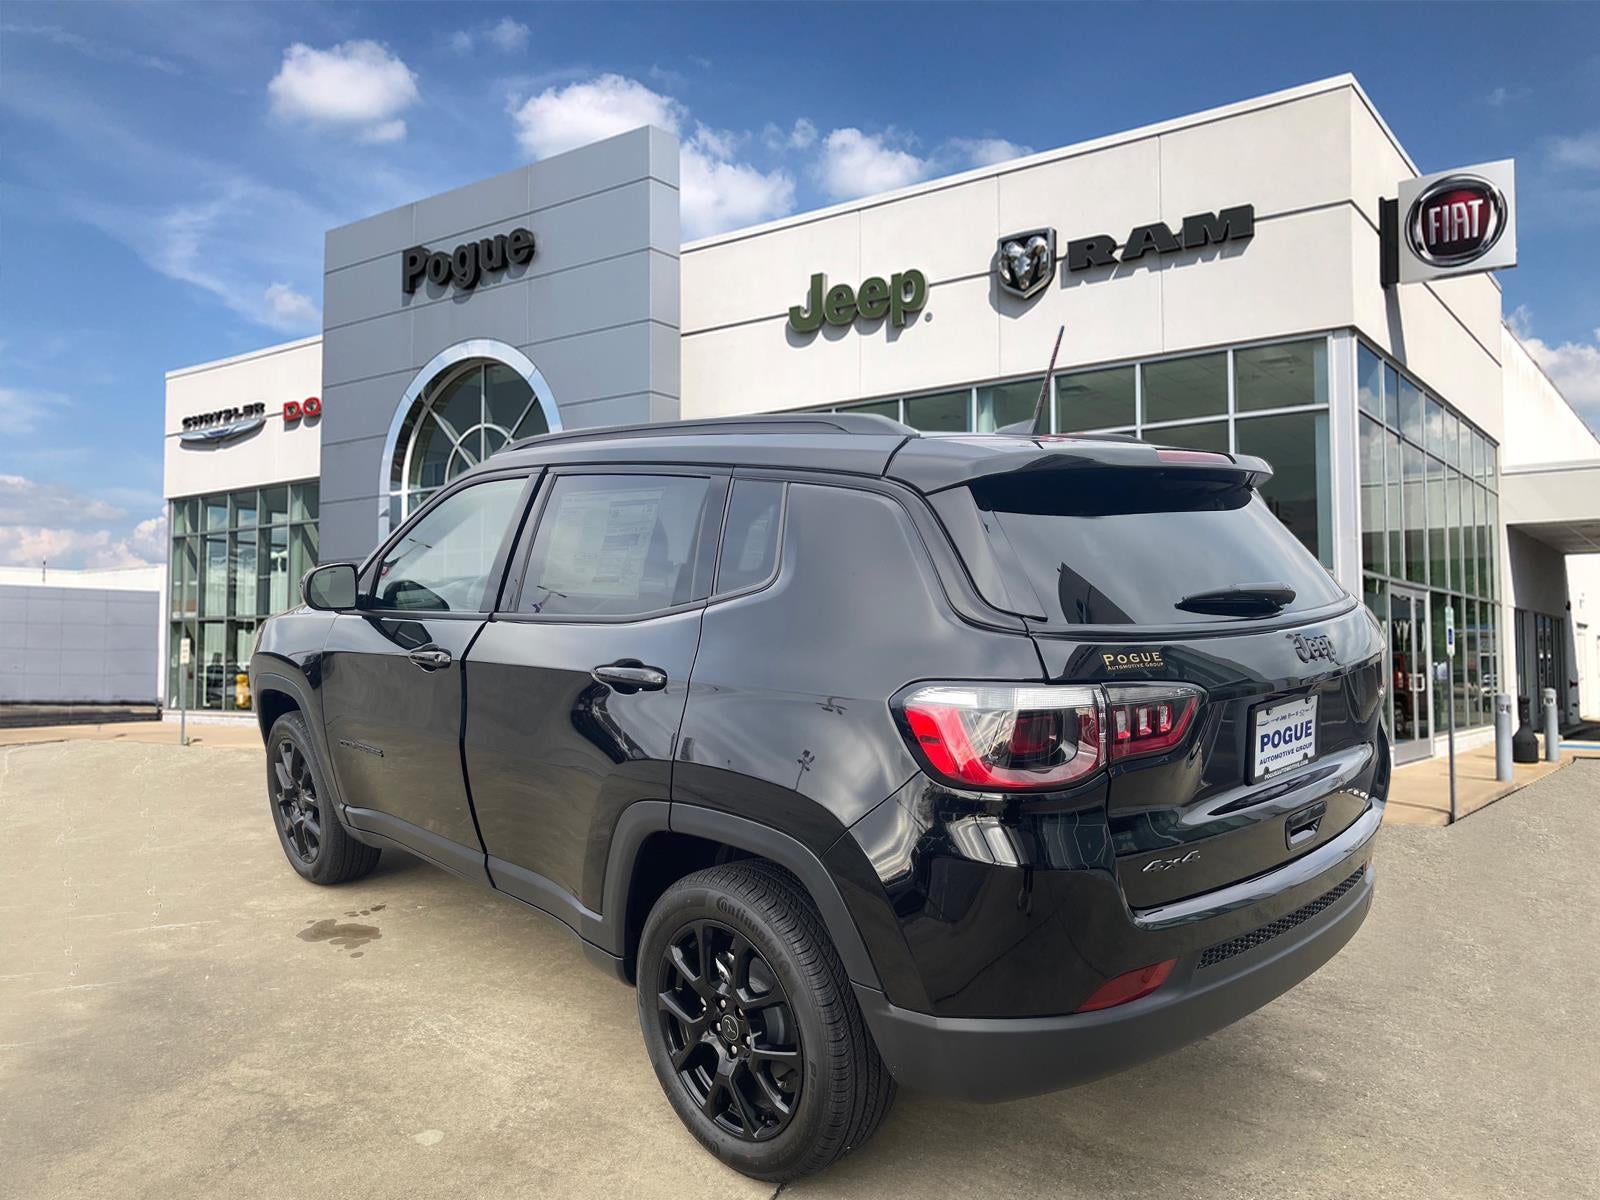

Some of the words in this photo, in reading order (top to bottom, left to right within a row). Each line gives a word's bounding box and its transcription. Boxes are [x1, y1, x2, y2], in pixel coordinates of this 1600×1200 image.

[1066, 203, 1255, 272] RAM
[1428, 199, 1484, 246] FIAT
[402, 228, 535, 294] Pogue
[789, 269, 929, 332] Jeep
[182, 402, 265, 429] CHRYSLER
[1103, 652, 1163, 666] POGUE
[1294, 633, 1340, 665] Jeep
[1260, 720, 1312, 753] POGUE
[1259, 748, 1294, 766] AUTOMOTIVE
[1295, 742, 1313, 752] GROUP
